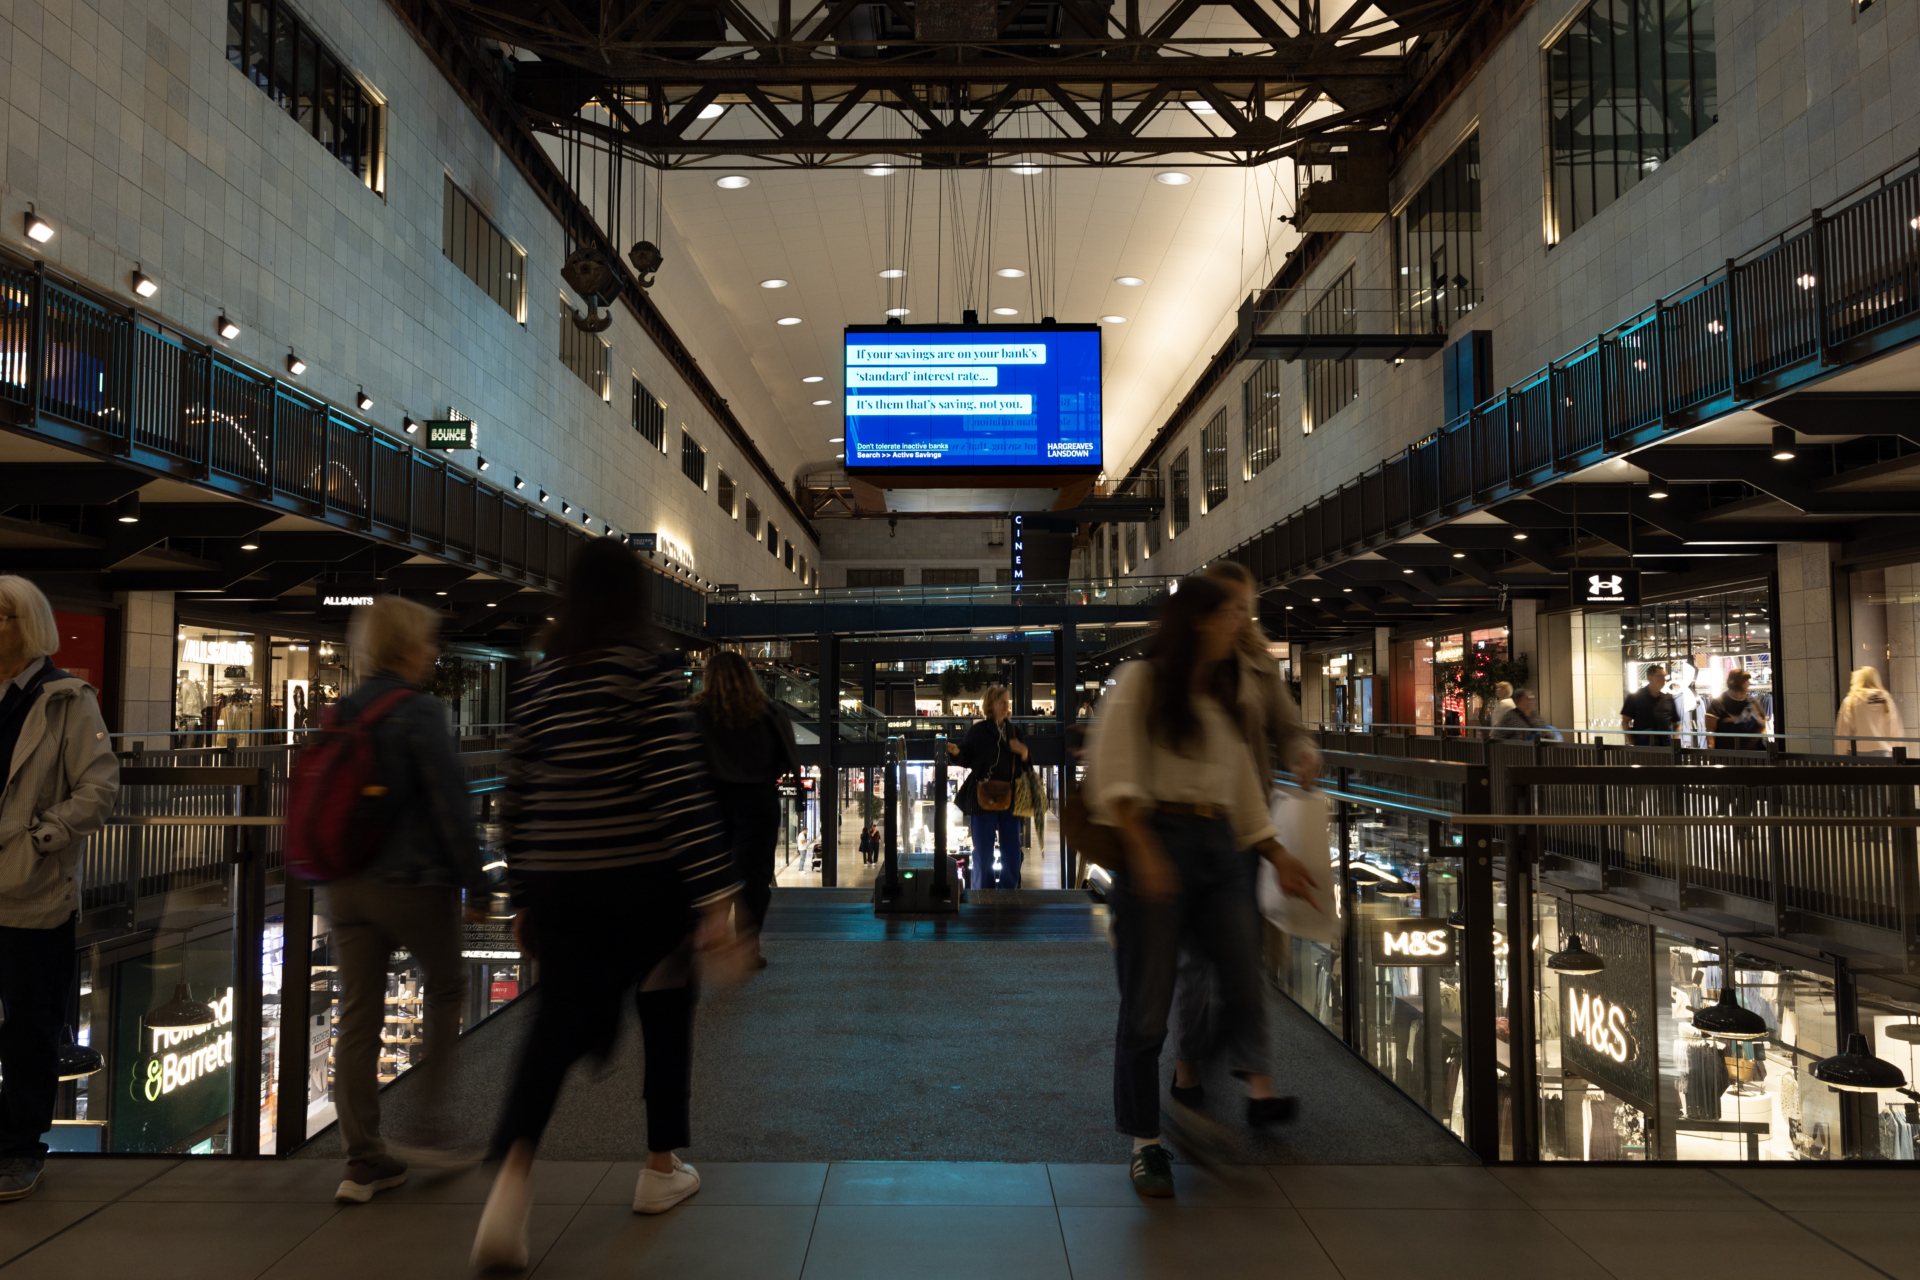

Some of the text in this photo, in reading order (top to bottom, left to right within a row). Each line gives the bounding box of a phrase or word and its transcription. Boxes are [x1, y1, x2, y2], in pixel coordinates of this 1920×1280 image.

[856, 347, 1038, 361] If your savings are on your bank’s
[913, 371, 956, 382] interest
[957, 371, 989, 382] rate...
[856, 399, 874, 410] It’s
[875, 399, 905, 410] them
[906, 399, 937, 410] that’s
[979, 399, 997, 410] not
[999, 400, 1023, 412] you.
[431, 429, 467, 441] BOUNCE
[857, 442, 874, 450] Don't
[875, 442, 901, 450] tolerate
[902, 442, 927, 450] inactive
[928, 442, 949, 450] banks
[1047, 442, 1094, 450] HARGREAVES
[857, 451, 881, 459] Search
[892, 451, 914, 459] Active
[914, 451, 942, 460] Savings
[1047, 450, 1089, 458] LANSDOWN
[1014, 515, 1024, 592] CINEMA
[323, 596, 375, 606] ALLSAINTS
[1383, 929, 1447, 956] M&S
[461, 950, 522, 959] SKECHERS
[1568, 987, 1628, 1063] M&S
[311, 1029, 330, 1046] SKECHERS
[161, 1031, 233, 1095] Barrett
